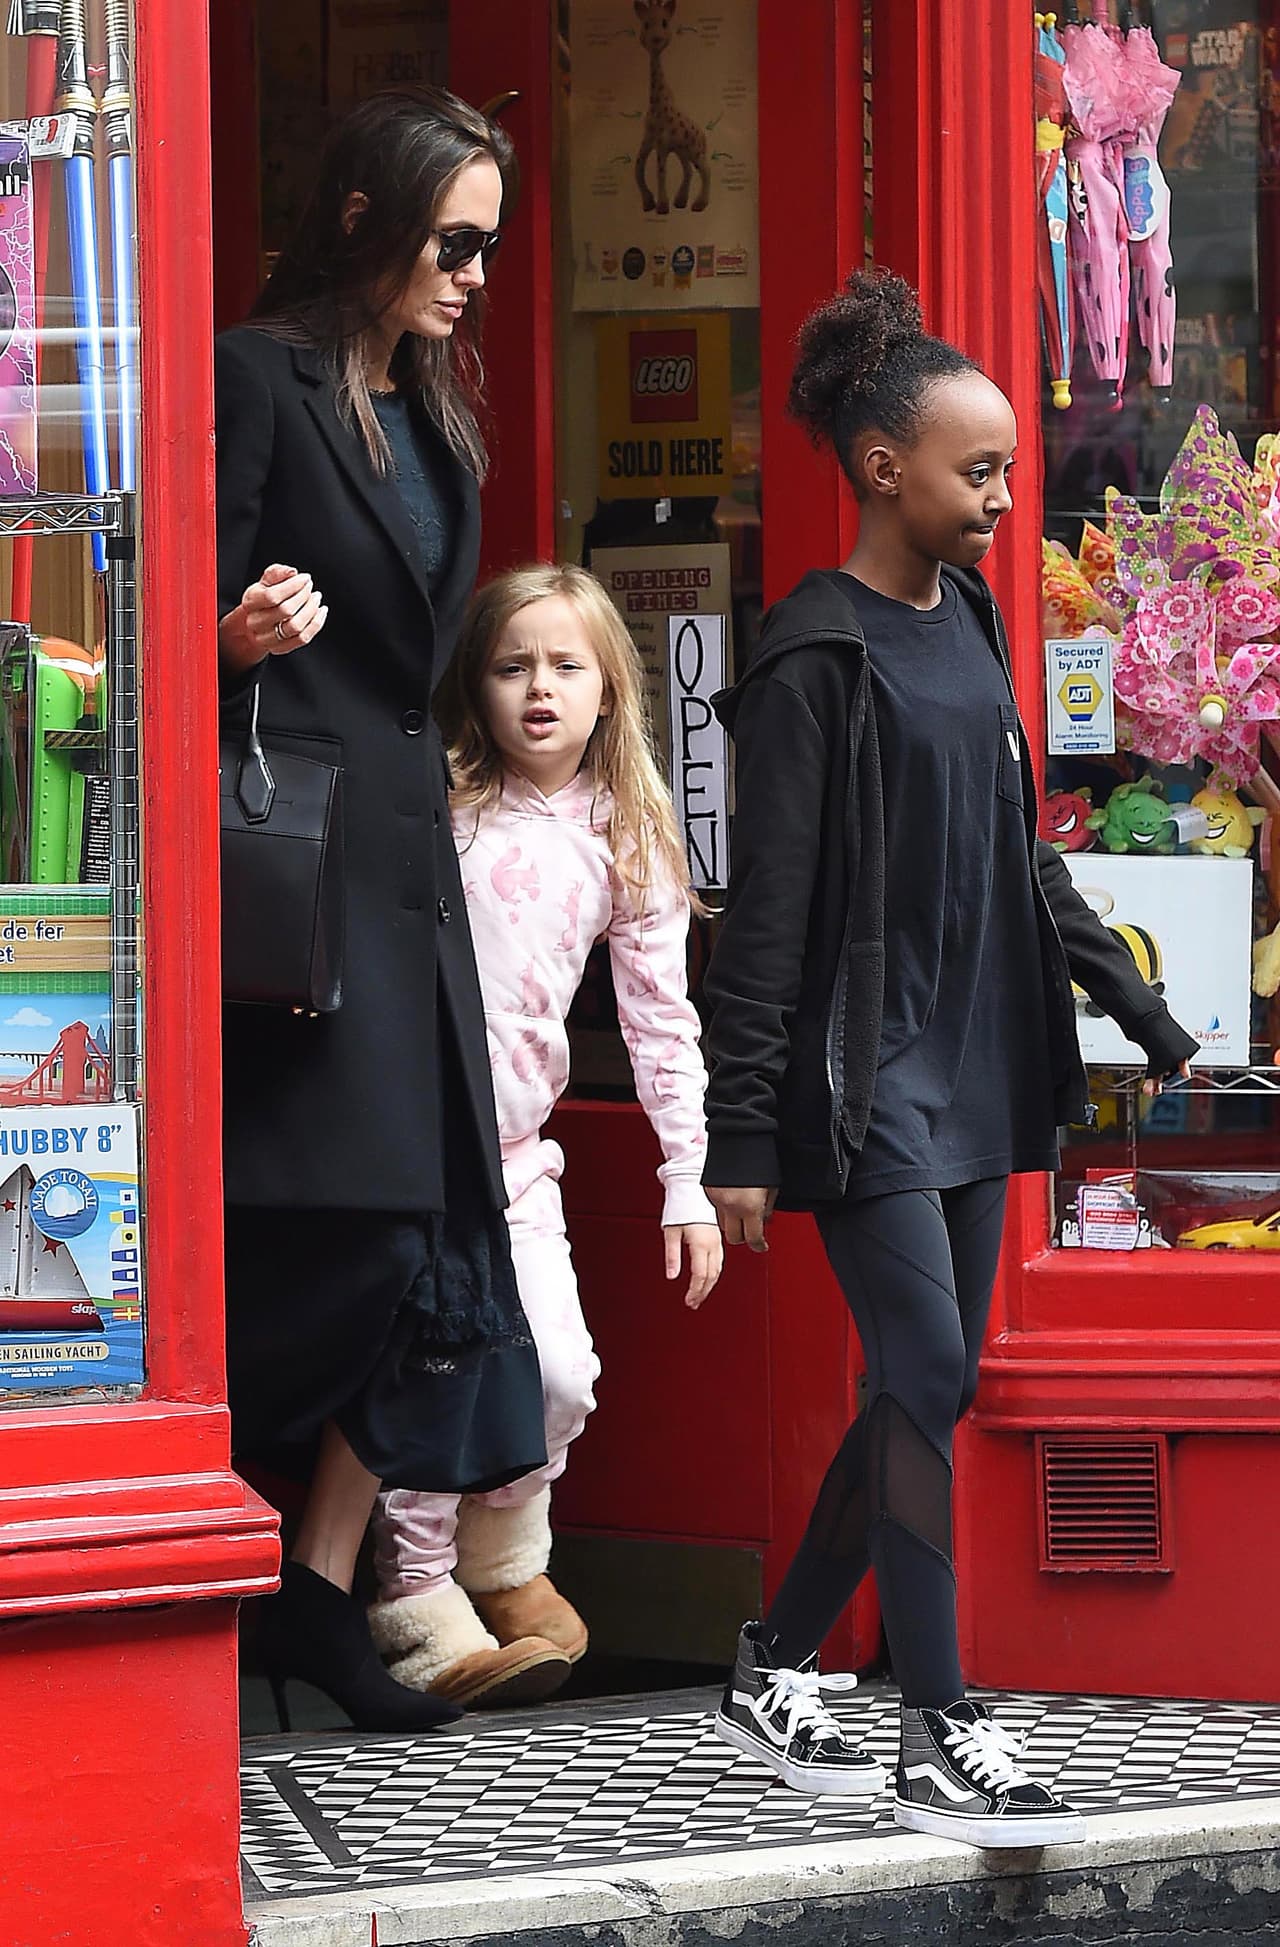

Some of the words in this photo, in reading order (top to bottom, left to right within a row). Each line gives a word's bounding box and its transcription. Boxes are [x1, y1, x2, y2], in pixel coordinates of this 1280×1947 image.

[1192, 29, 1243, 48] STAR
[1192, 47, 1243, 67] WARS
[634, 356, 694, 395] LEGO
[608, 440, 663, 478] SOLD
[670, 437, 724, 476] HERE
[613, 568, 711, 590] OPENING
[627, 592, 697, 611] TIMES
[1055, 646, 1104, 657] Secured
[1058, 660, 1073, 672] by
[1076, 659, 1101, 670] ADT
[1069, 687, 1091, 702] ADT
[675, 619, 721, 886] OPEN
[3, 920, 27, 940] de
[36, 920, 64, 940] fer
[32, 1173, 59, 1211] MADE
[60, 1171, 79, 1184] TO
[77, 1179, 97, 1210] SAIL
[15, 1347, 62, 1360] SAILING
[65, 1345, 102, 1358] YACHT
